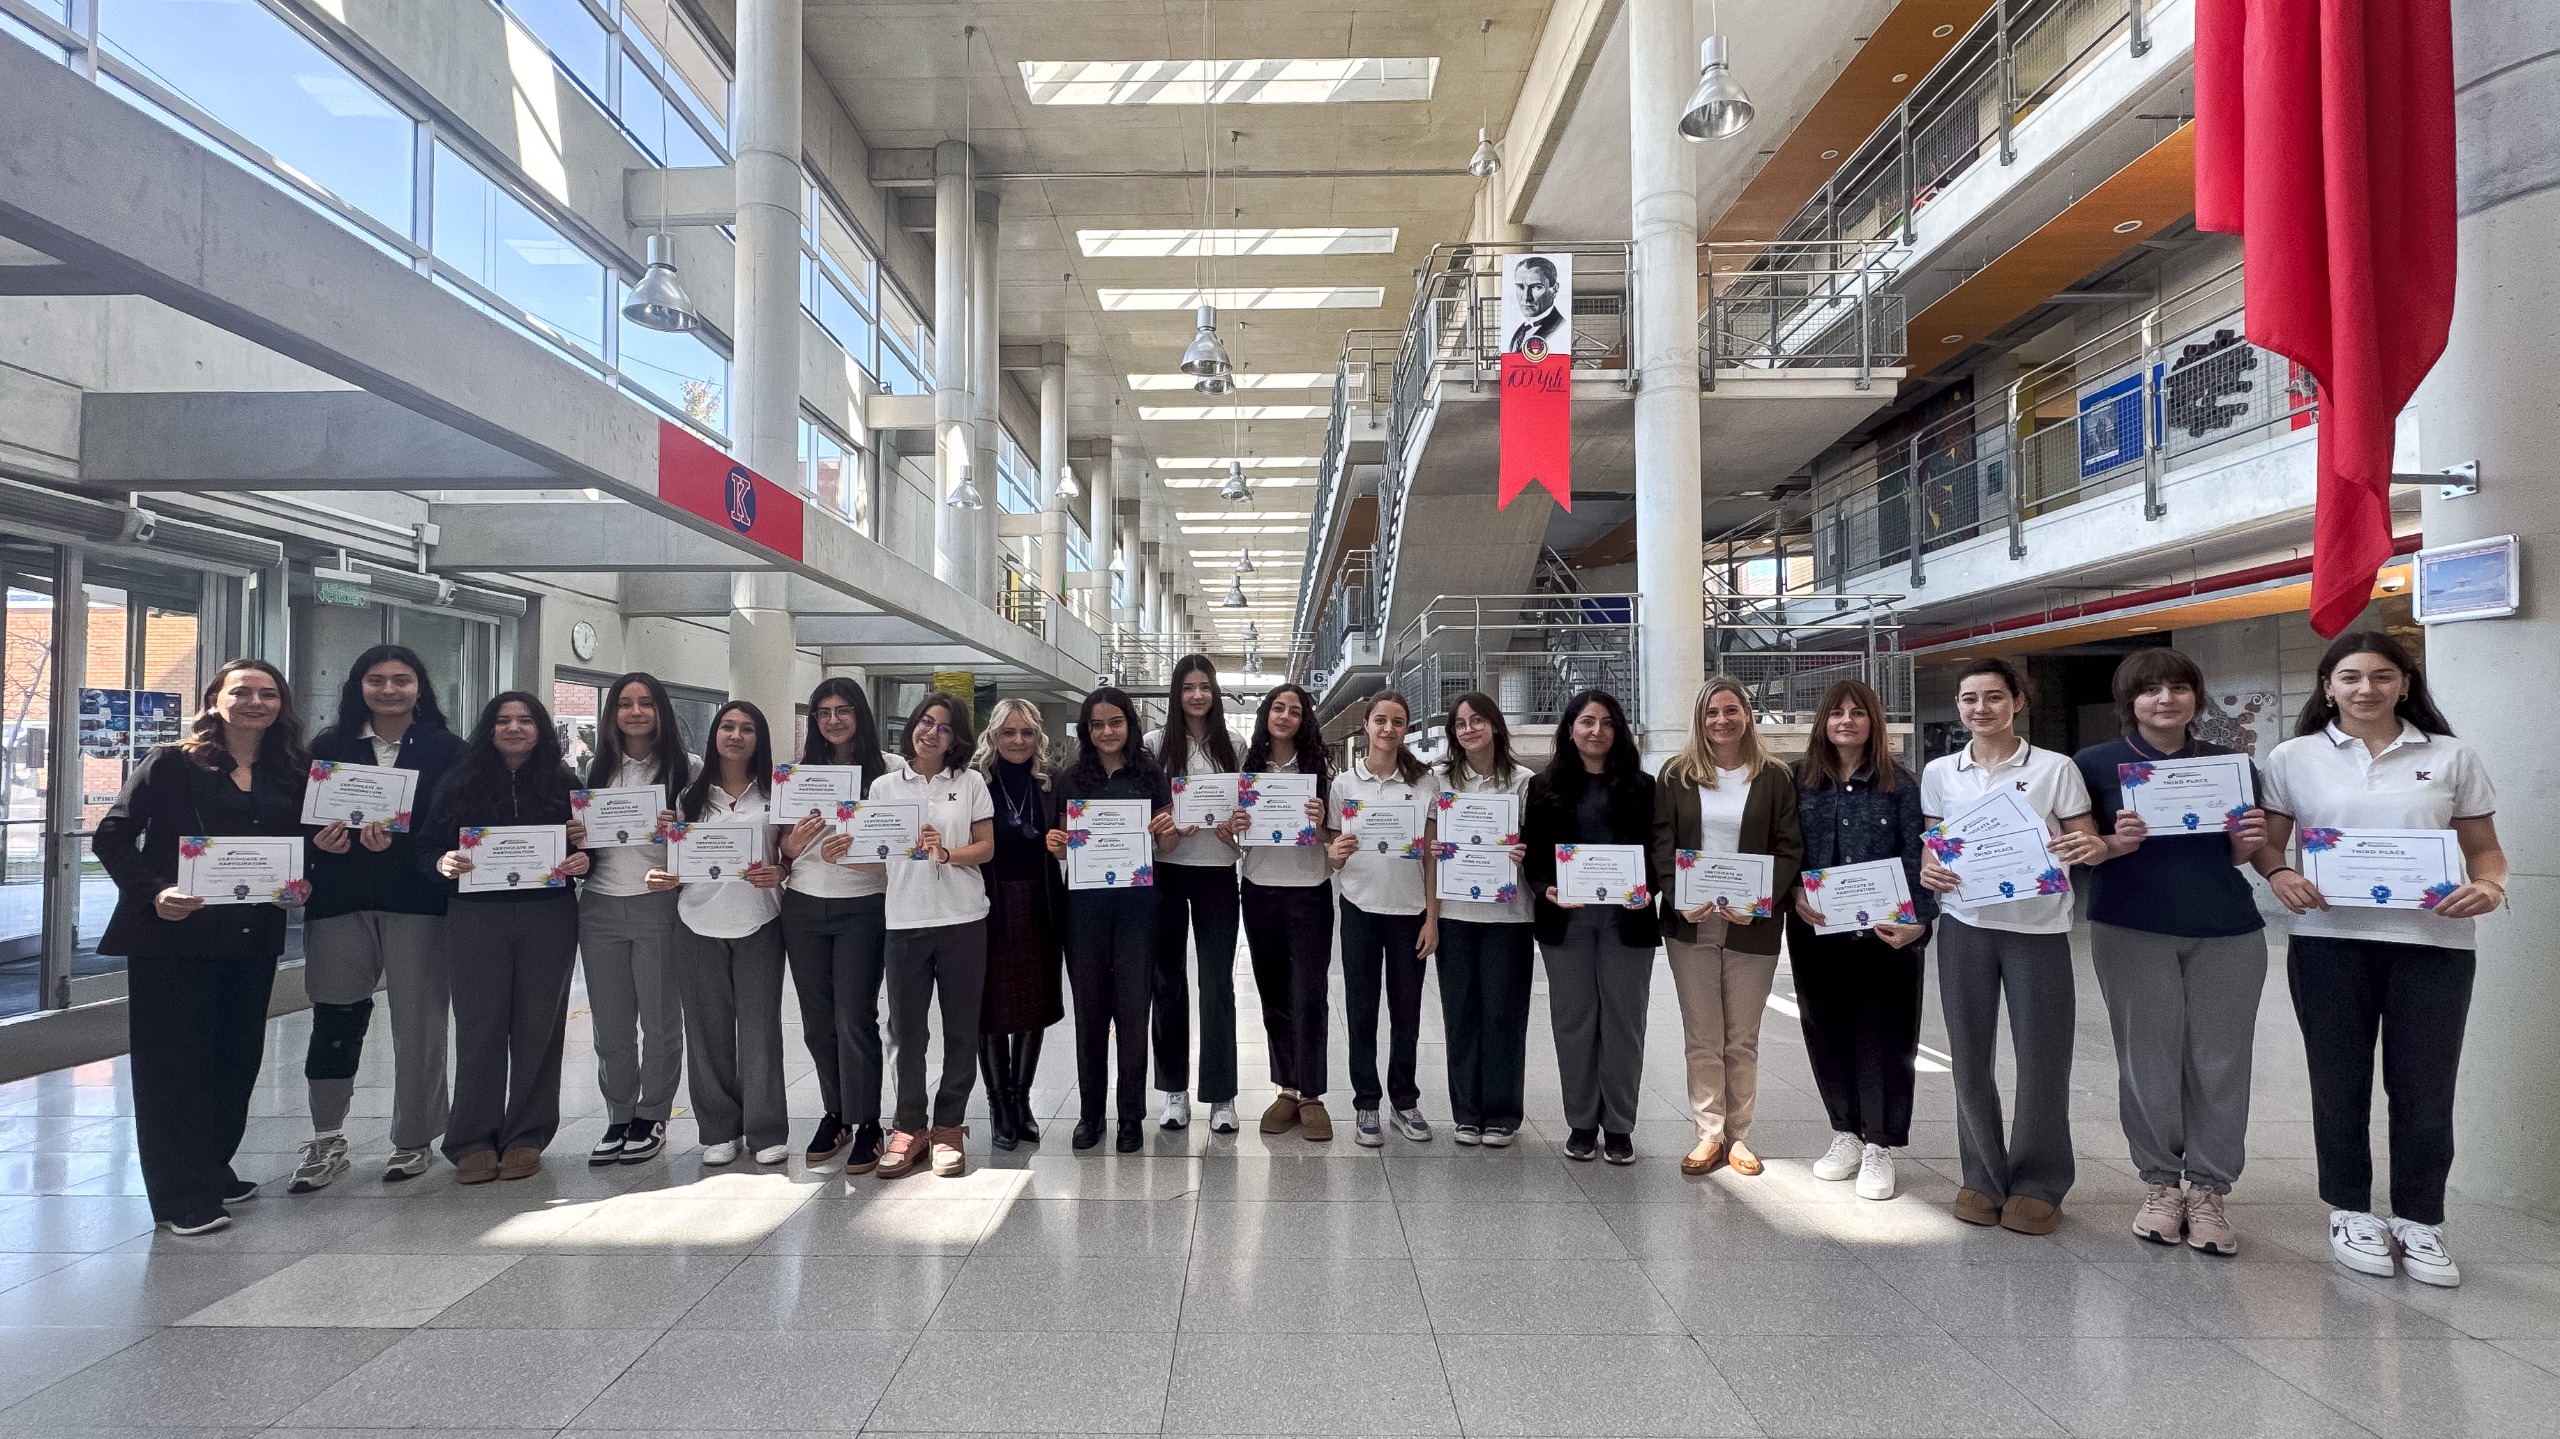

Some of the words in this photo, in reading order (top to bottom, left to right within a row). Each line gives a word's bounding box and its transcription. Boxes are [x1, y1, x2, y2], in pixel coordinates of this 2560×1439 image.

[731, 473, 750, 526] K
[2416, 771, 2432, 781] K
[2016, 781, 2028, 792] K
[947, 793, 957, 801] K
